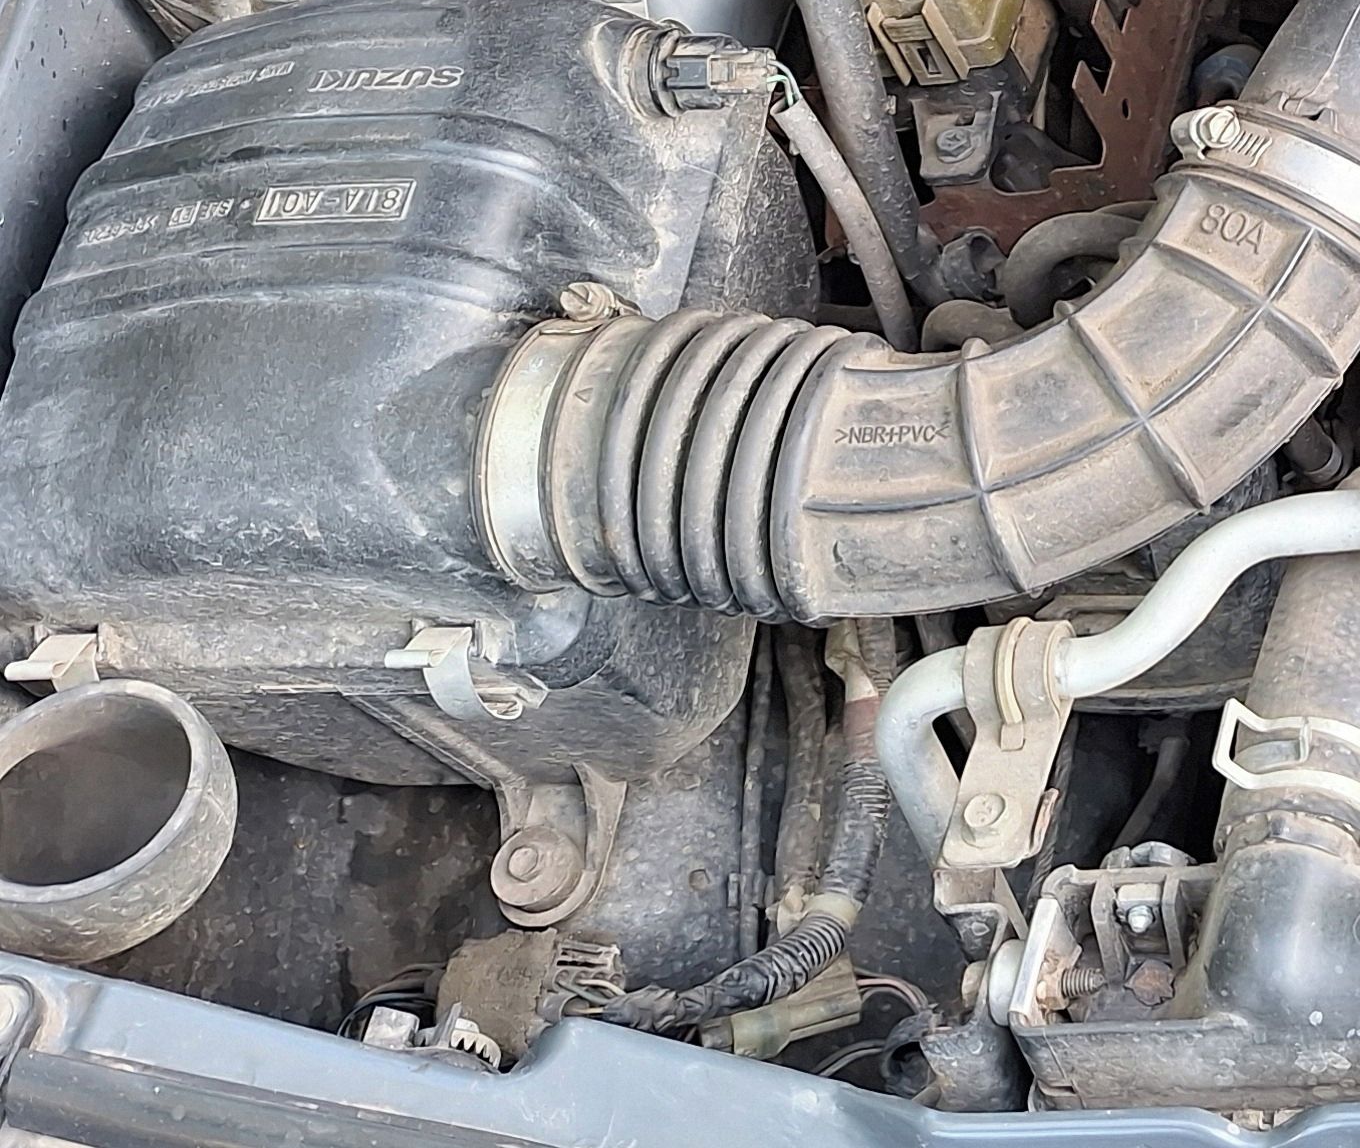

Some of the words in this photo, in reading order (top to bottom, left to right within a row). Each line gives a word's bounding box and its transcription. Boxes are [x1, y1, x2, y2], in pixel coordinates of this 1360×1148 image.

[307, 66, 465, 93] SUZUKI
[269, 188, 402, 214] 81A-A01
[1200, 204, 1263, 255] 80A
